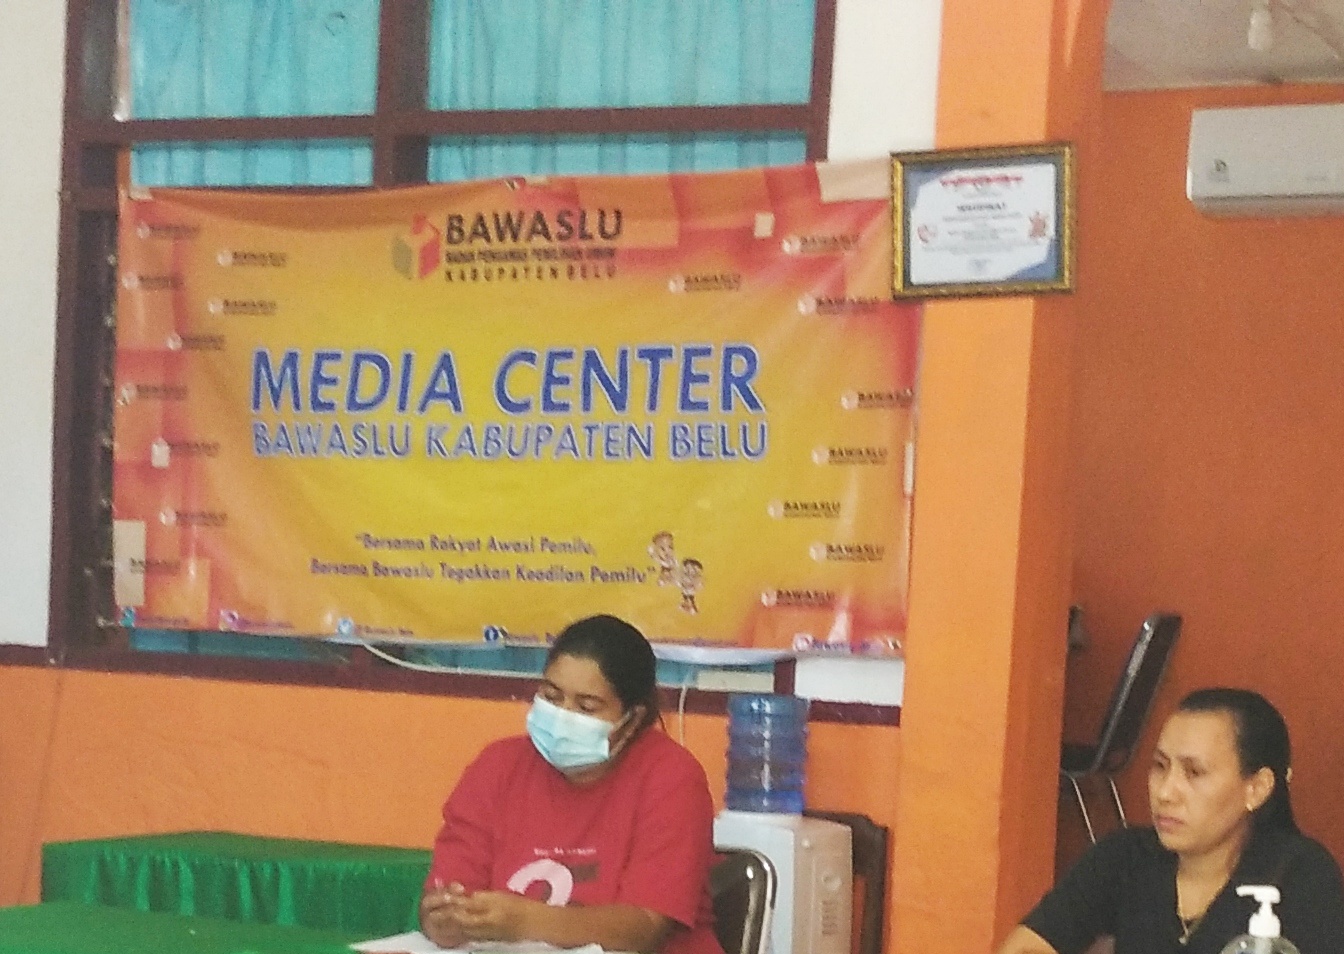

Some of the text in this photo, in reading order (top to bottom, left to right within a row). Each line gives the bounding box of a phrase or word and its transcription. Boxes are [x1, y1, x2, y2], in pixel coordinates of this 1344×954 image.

[445, 208, 622, 246] BAWASLU
[251, 345, 766, 414] MEDIA CENTER
[253, 420, 768, 461] BAWASLU KABUPATEN BELU
[430, 534, 481, 555] Rakyat
[311, 557, 369, 576] Bersama
